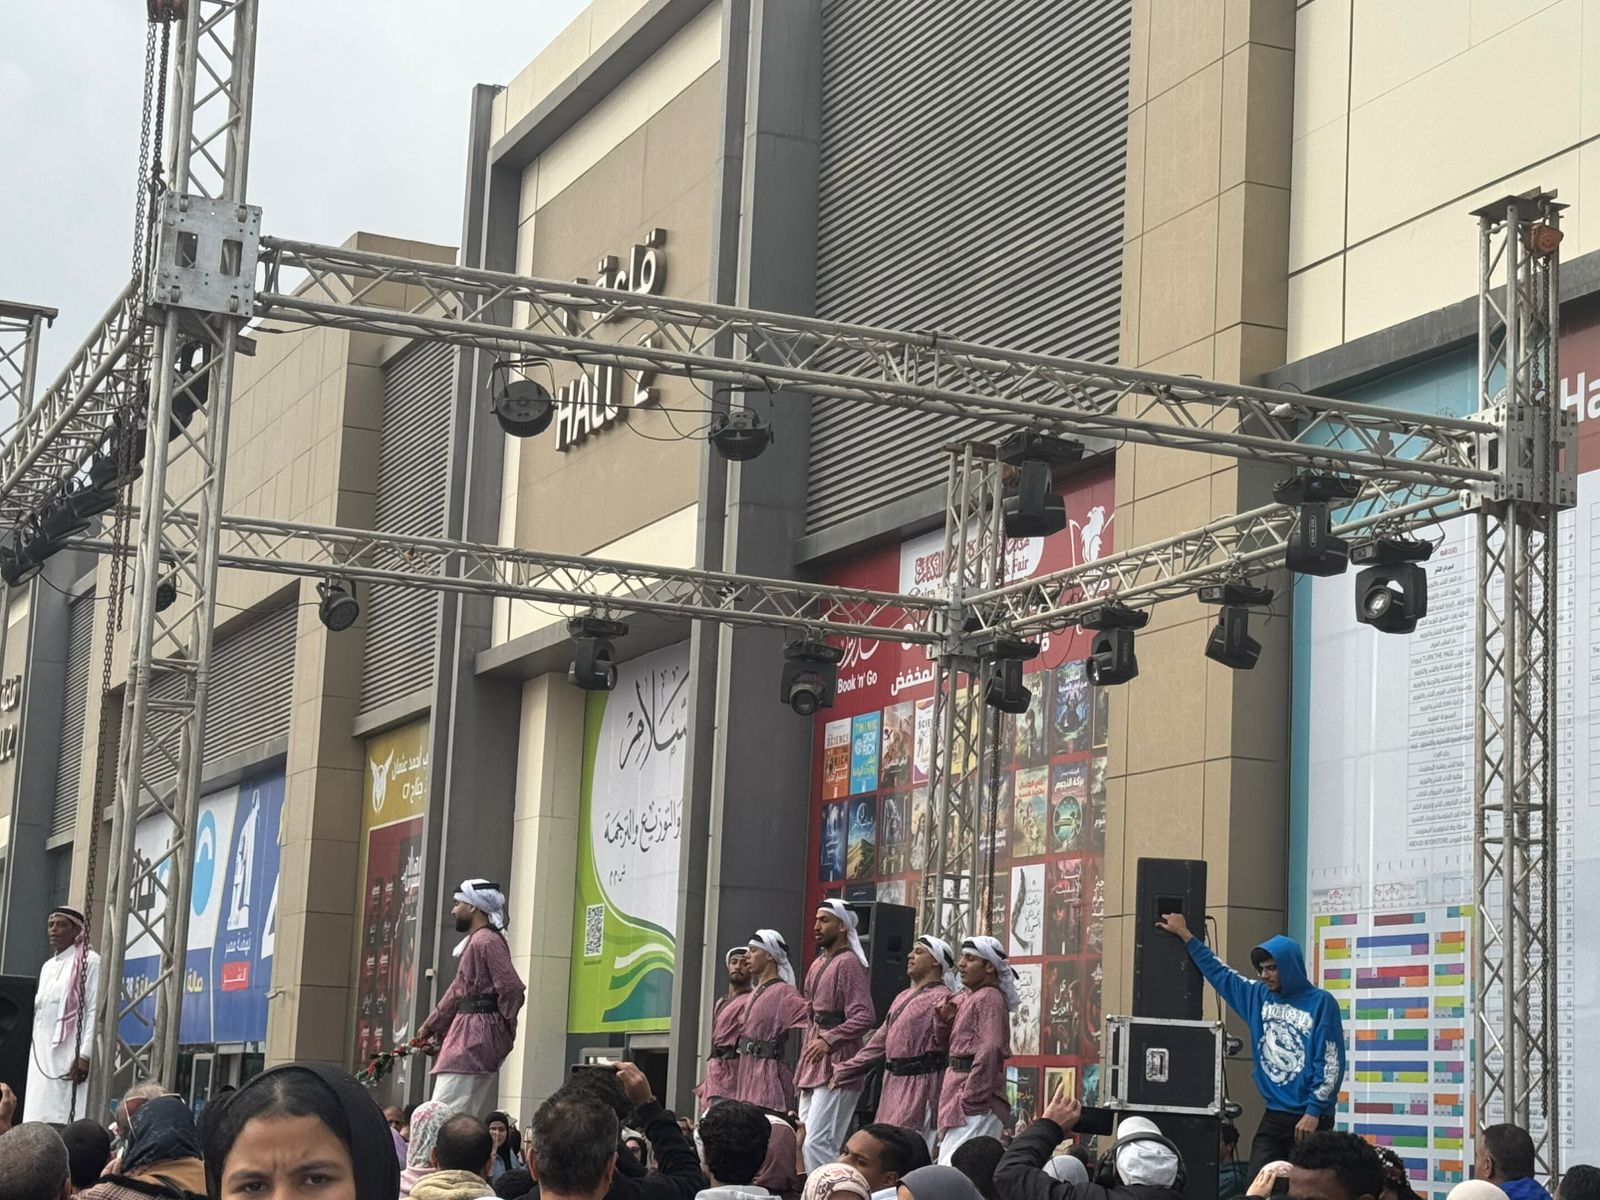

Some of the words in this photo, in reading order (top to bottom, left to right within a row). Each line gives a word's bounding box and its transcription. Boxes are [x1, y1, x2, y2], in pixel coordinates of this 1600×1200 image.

[1013, 555, 1029, 572] Fair
[837, 674, 856, 694] Book
[866, 669, 878, 686] Go
[827, 733, 849, 747] SCIENCE
